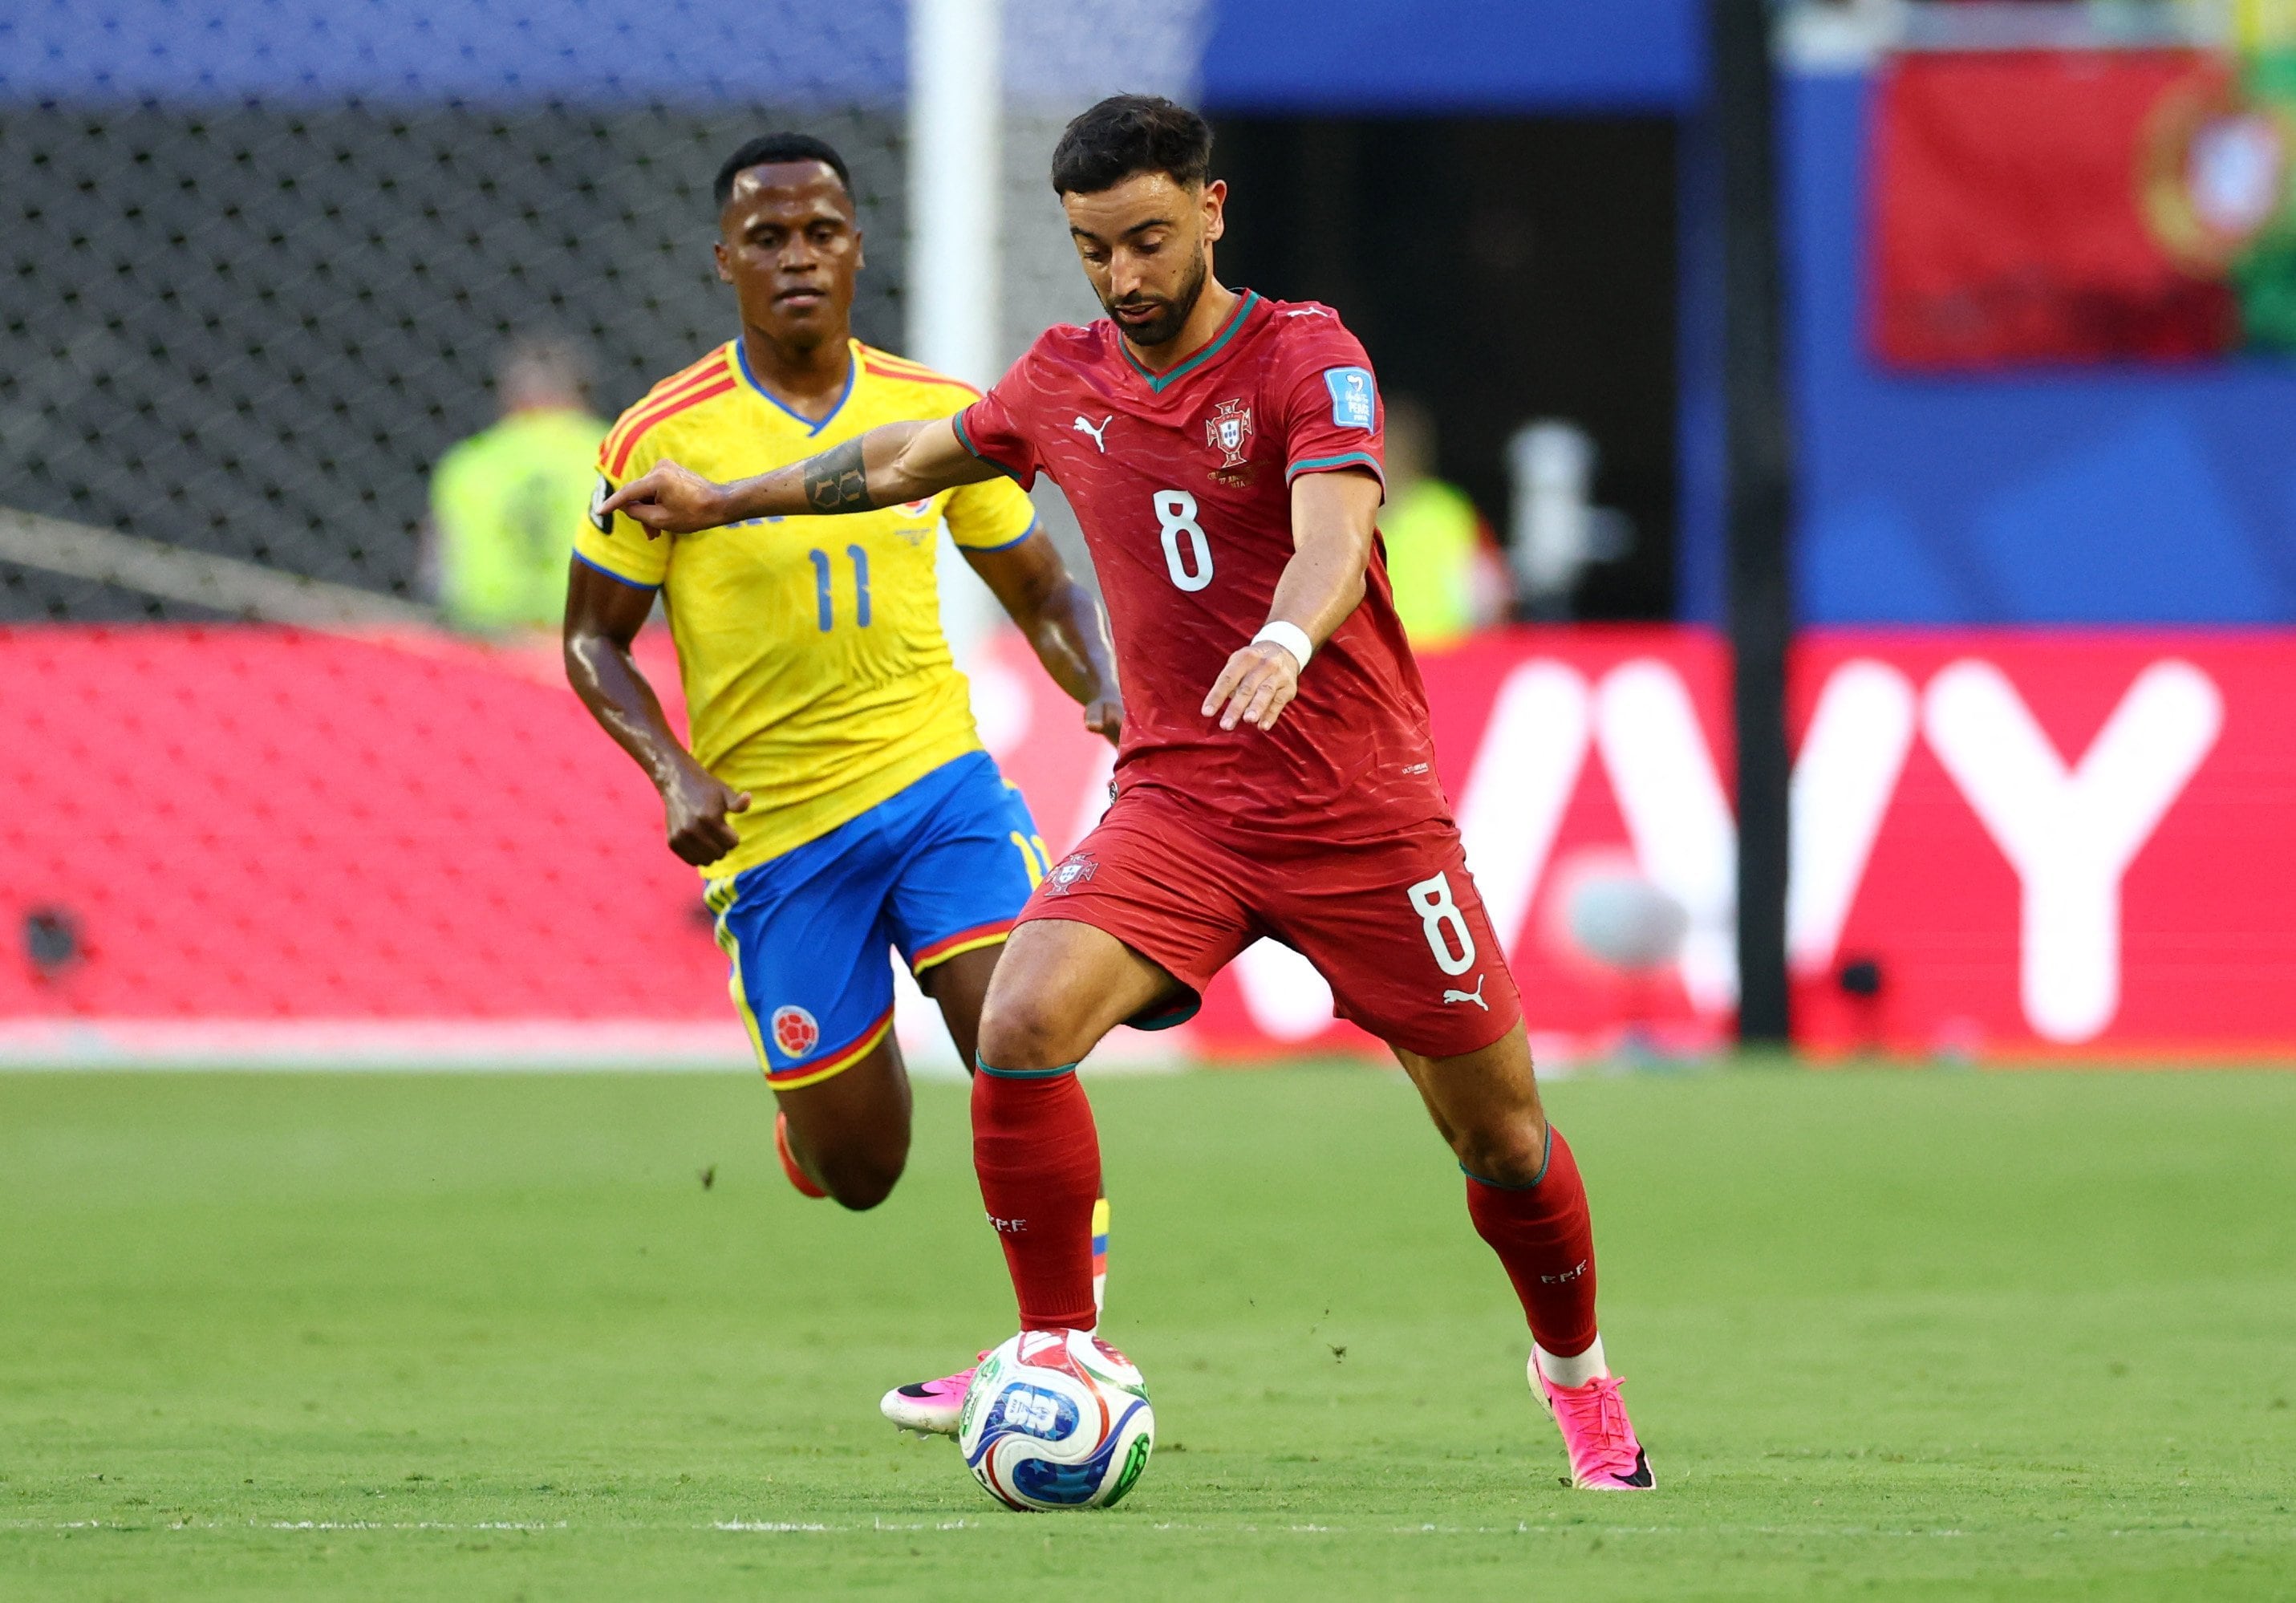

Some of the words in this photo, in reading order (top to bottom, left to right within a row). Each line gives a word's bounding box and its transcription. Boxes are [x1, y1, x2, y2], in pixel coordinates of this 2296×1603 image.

[809, 545, 870, 632] 11
[1153, 489, 1214, 592] 8
[1406, 870, 1475, 976] 8
